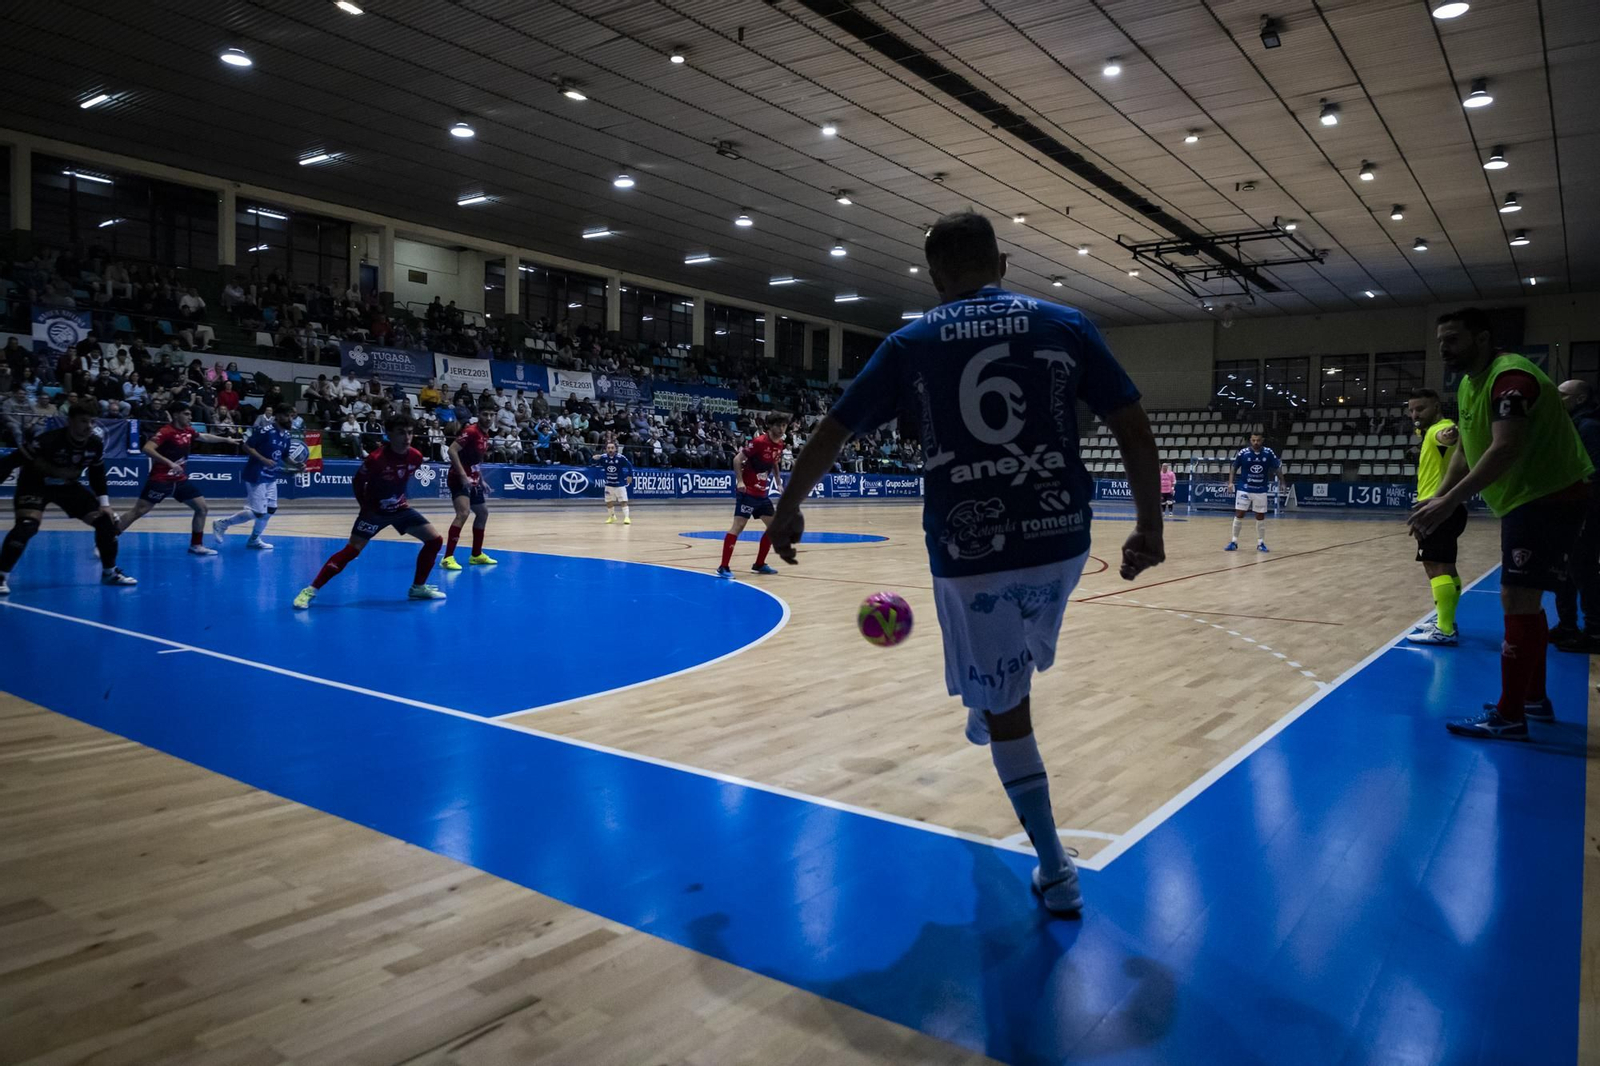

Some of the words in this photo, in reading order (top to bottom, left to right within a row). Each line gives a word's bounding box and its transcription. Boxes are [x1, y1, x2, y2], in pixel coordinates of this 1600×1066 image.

[927, 299, 1039, 324] INVERCAR
[940, 316, 1029, 342] CHICHO
[371, 351, 412, 364] TUGASA
[373, 360, 416, 373] HOTELES
[613, 380, 638, 389] TUGASA
[958, 342, 1027, 445] 6
[188, 472, 233, 481] EXUS
[314, 472, 353, 484] CAYETAN
[526, 472, 557, 481] Diputación
[633, 476, 656, 490] JEREZ
[657, 476, 675, 490] 2031
[535, 481, 552, 491] Cádiz
[886, 479, 900, 489] Grupo
[901, 479, 915, 488] Solera
[1021, 508, 1084, 532] romeral
